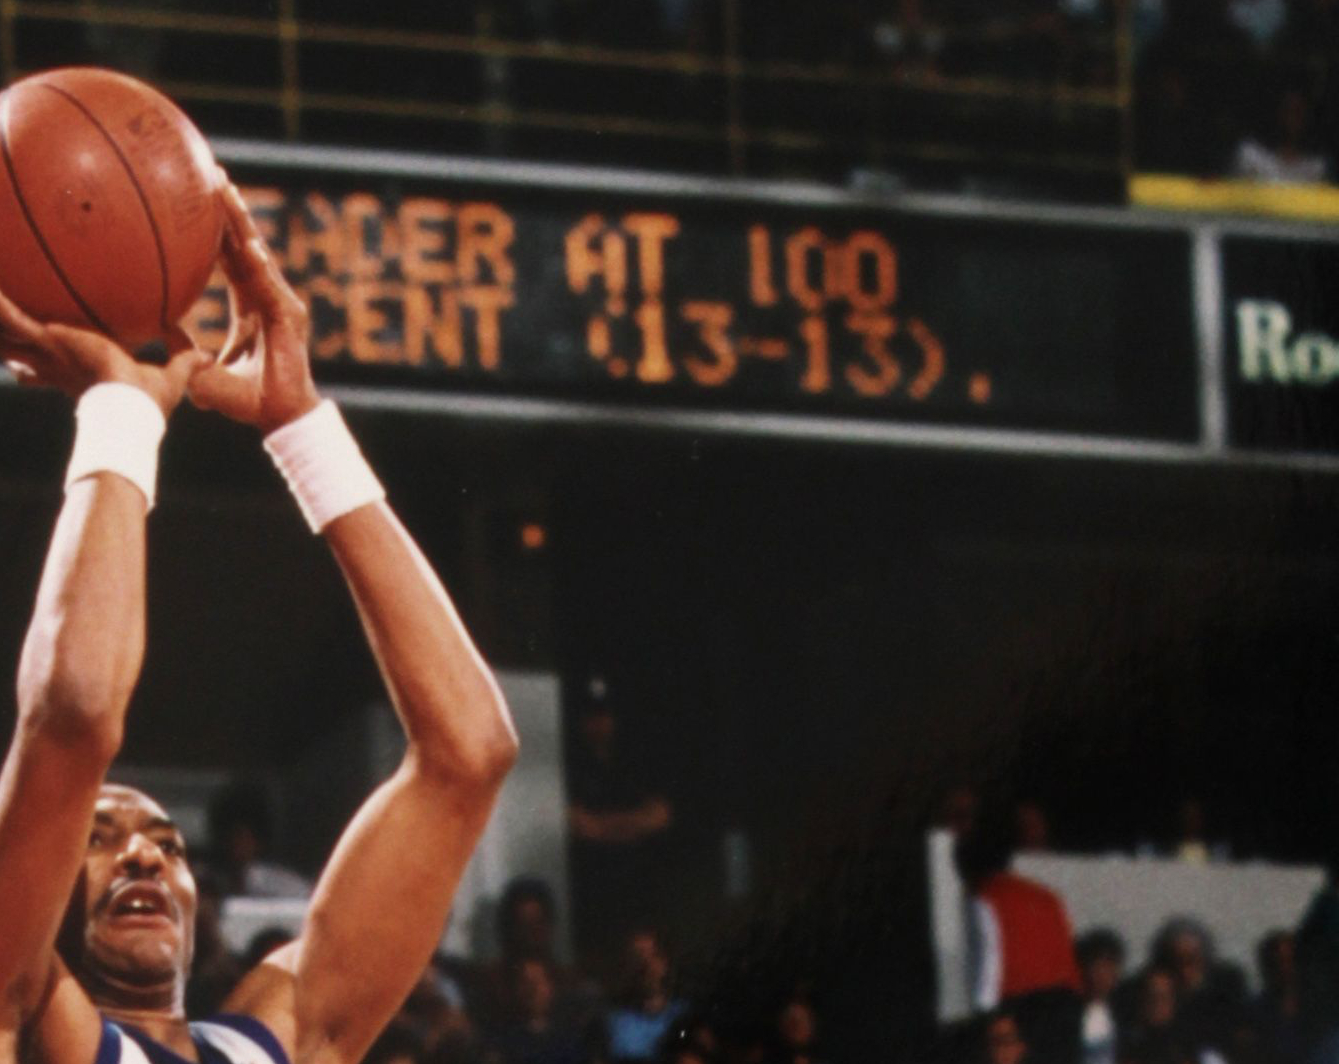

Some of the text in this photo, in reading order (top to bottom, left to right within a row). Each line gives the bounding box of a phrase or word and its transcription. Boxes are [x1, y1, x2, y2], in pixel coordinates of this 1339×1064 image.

[239, 188, 898, 312] EADER AT 100
[1236, 299, 1339, 388] Ro
